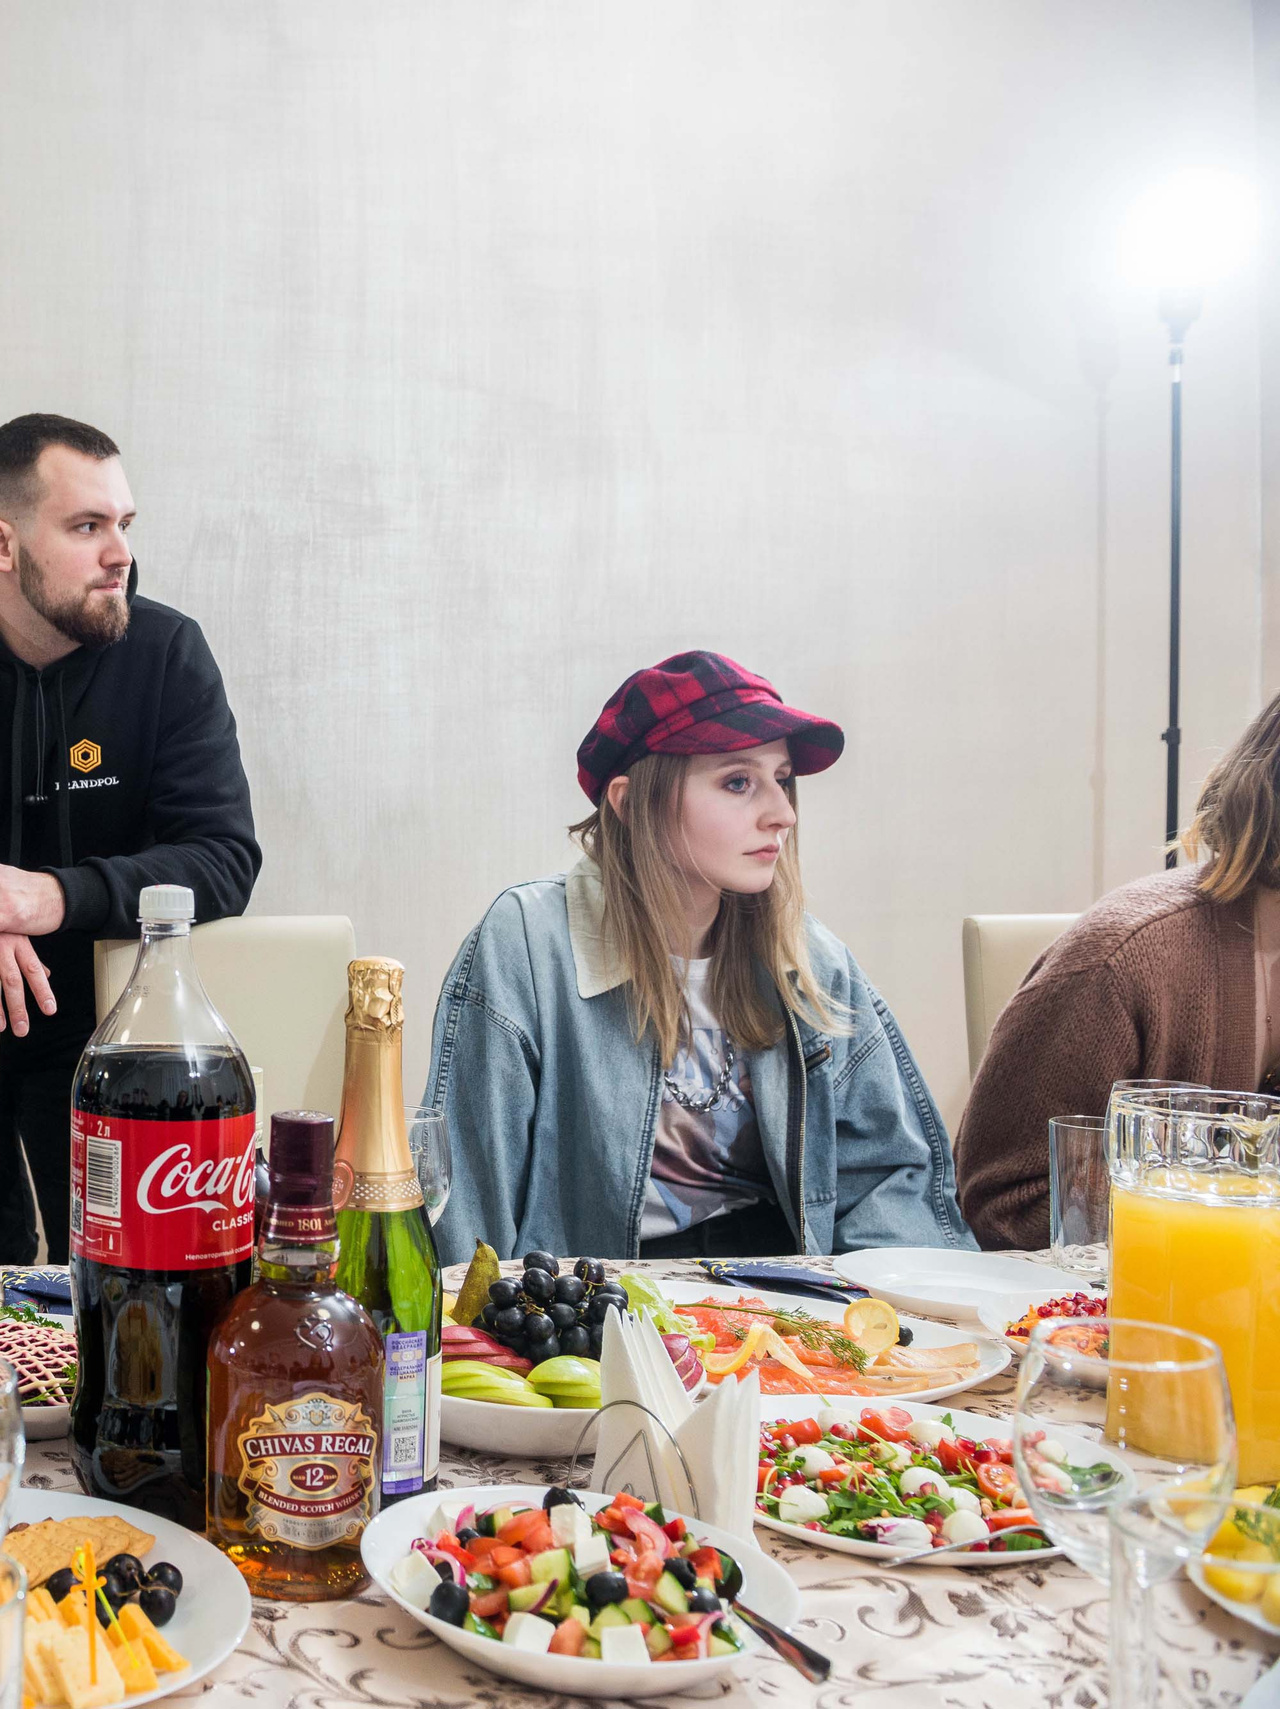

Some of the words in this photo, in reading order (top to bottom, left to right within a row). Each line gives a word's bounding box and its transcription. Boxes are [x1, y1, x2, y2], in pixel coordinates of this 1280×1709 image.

[212, 1210, 253, 1232] CLASSIC
[297, 1218, 323, 1231] 1801
[246, 1435, 315, 1457] CHIVAS
[321, 1435, 371, 1455] REGAL
[305, 1467, 324, 1486] 12
[258, 1490, 299, 1512] BLENDED
[300, 1502, 335, 1514] SCOTCH
[335, 1489, 364, 1510] WHISKY
